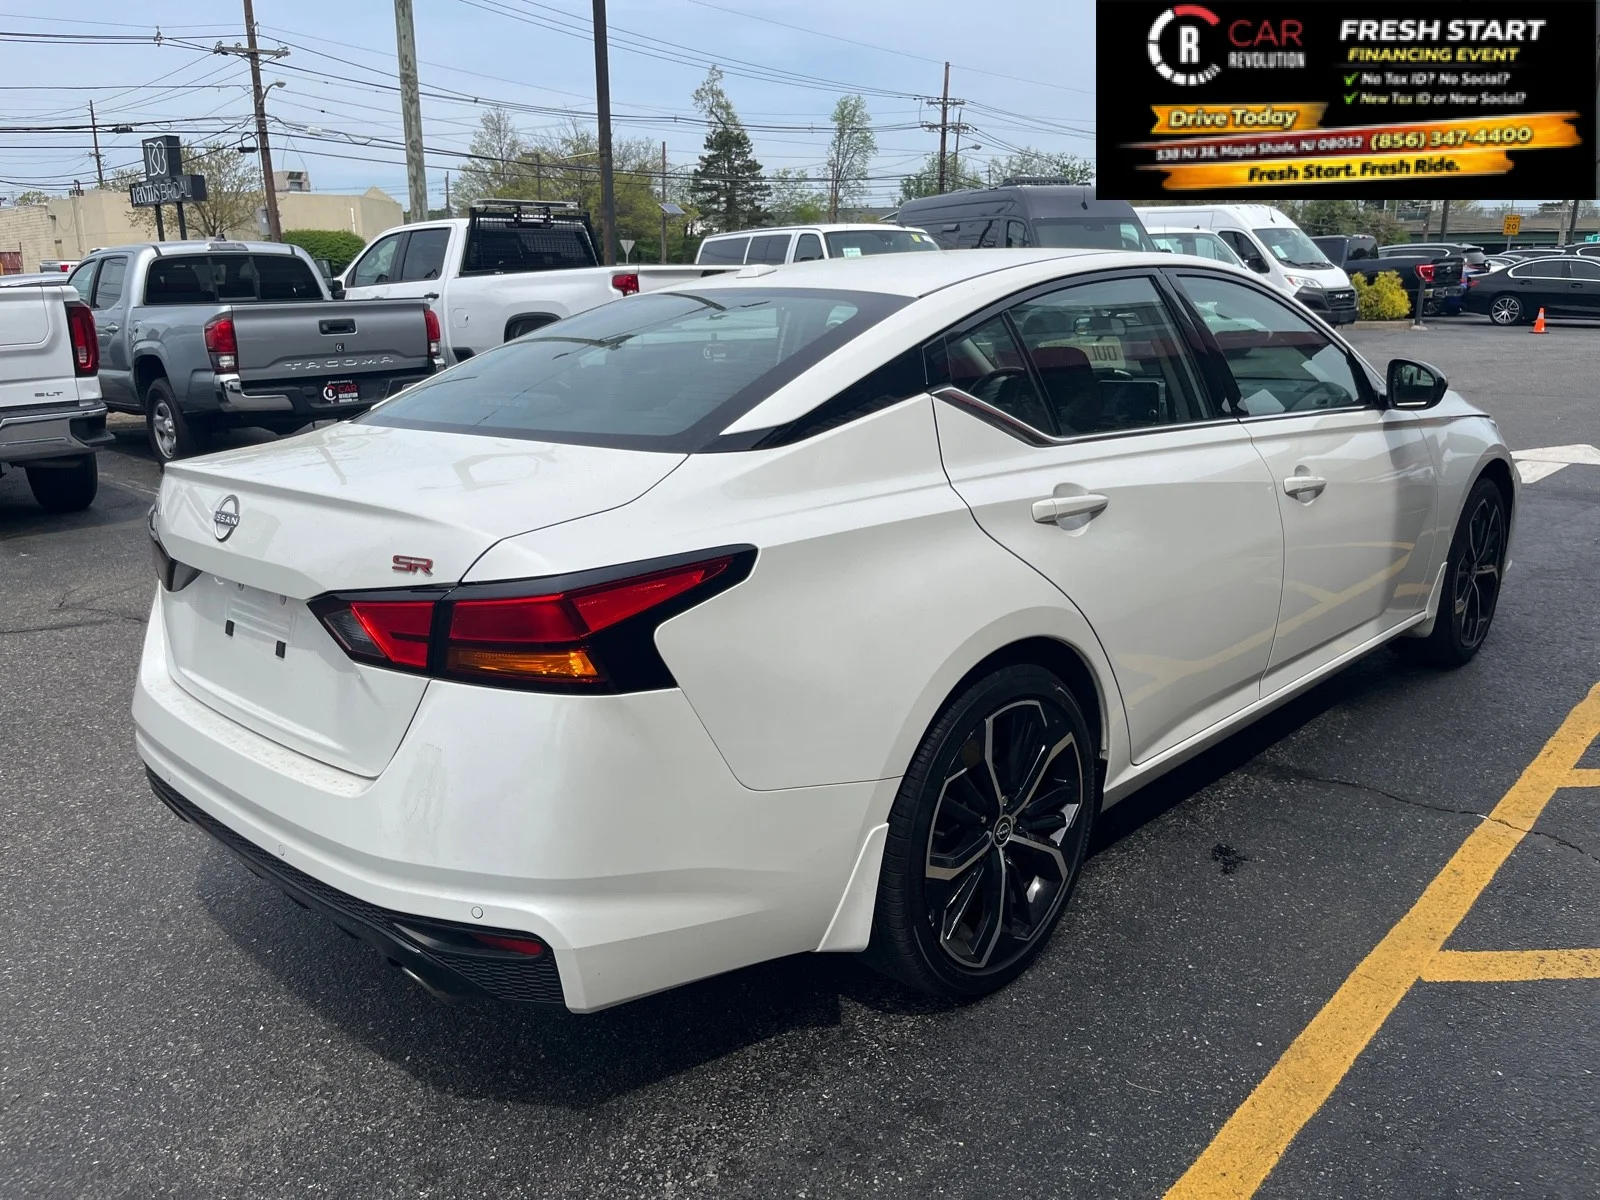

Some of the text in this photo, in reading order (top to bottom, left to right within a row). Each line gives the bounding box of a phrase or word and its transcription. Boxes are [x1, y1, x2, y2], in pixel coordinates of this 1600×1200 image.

[284, 356, 394, 370] TACOMA
[338, 384, 358, 392] CAR
[214, 512, 239, 526] SSAN
[392, 554, 434, 577] SR
